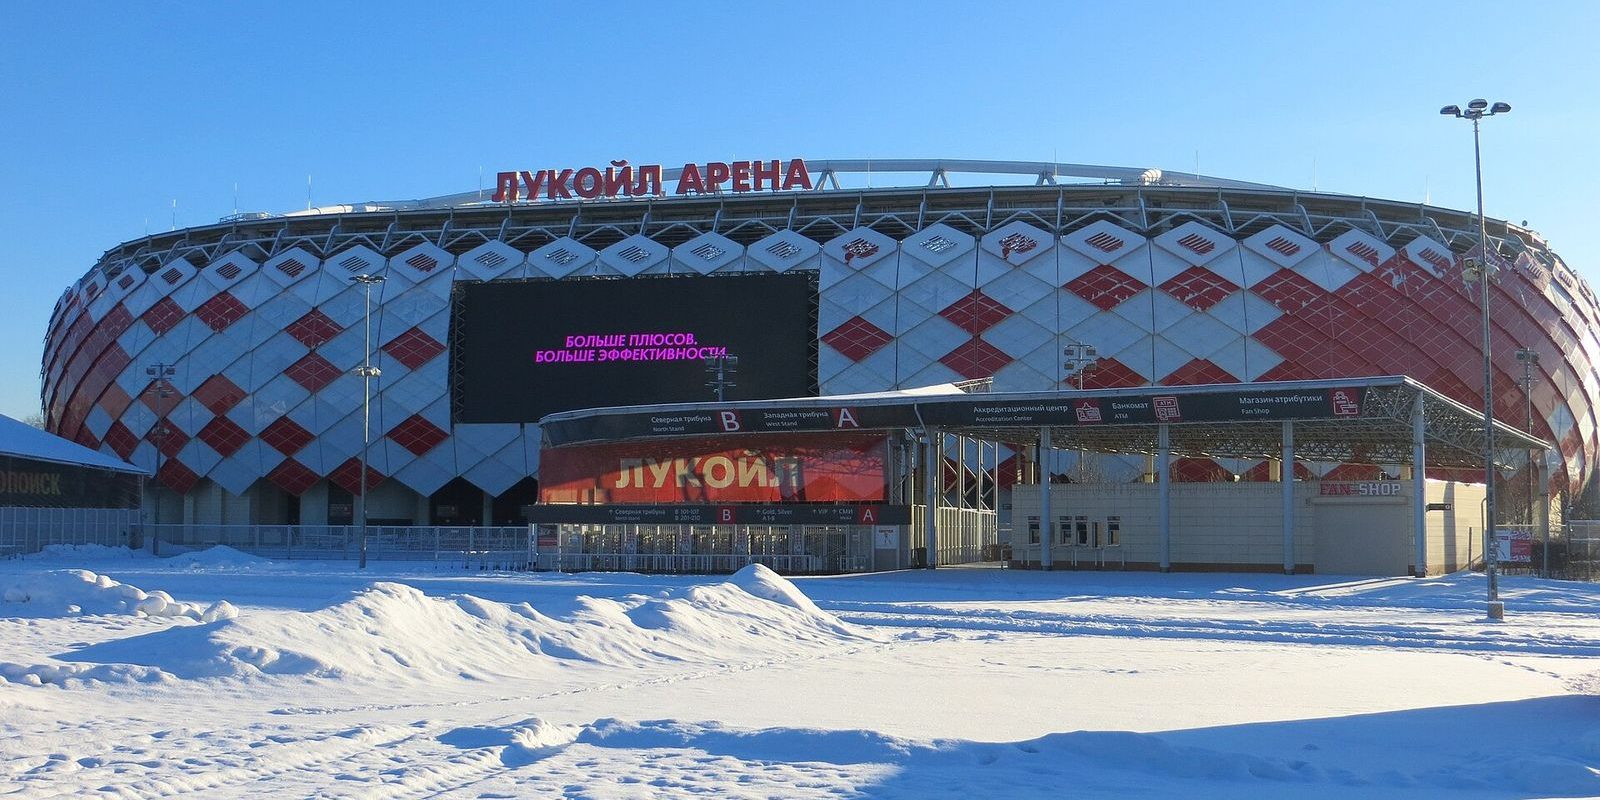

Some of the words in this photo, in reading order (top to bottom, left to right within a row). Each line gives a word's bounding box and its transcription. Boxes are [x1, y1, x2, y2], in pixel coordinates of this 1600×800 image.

[491, 159, 663, 203] ЛУКОЙЛ
[676, 158, 813, 194] АРЕНА
[565, 335, 626, 348] БОЛЬШЕ
[629, 332, 698, 346] ПЛЮСОВ.
[535, 349, 595, 363] БОЛЬШЕ
[1239, 397, 1274, 405] Магазин
[1275, 395, 1323, 404] атрибутики
[973, 405, 1045, 414] Аккредитационный
[1045, 404, 1069, 413] центр
[1111, 402, 1149, 410] Банкомат
[651, 415, 683, 424] Северная
[684, 414, 712, 423] трибуна
[763, 411, 798, 419] Западная
[799, 410, 829, 419] трибуна
